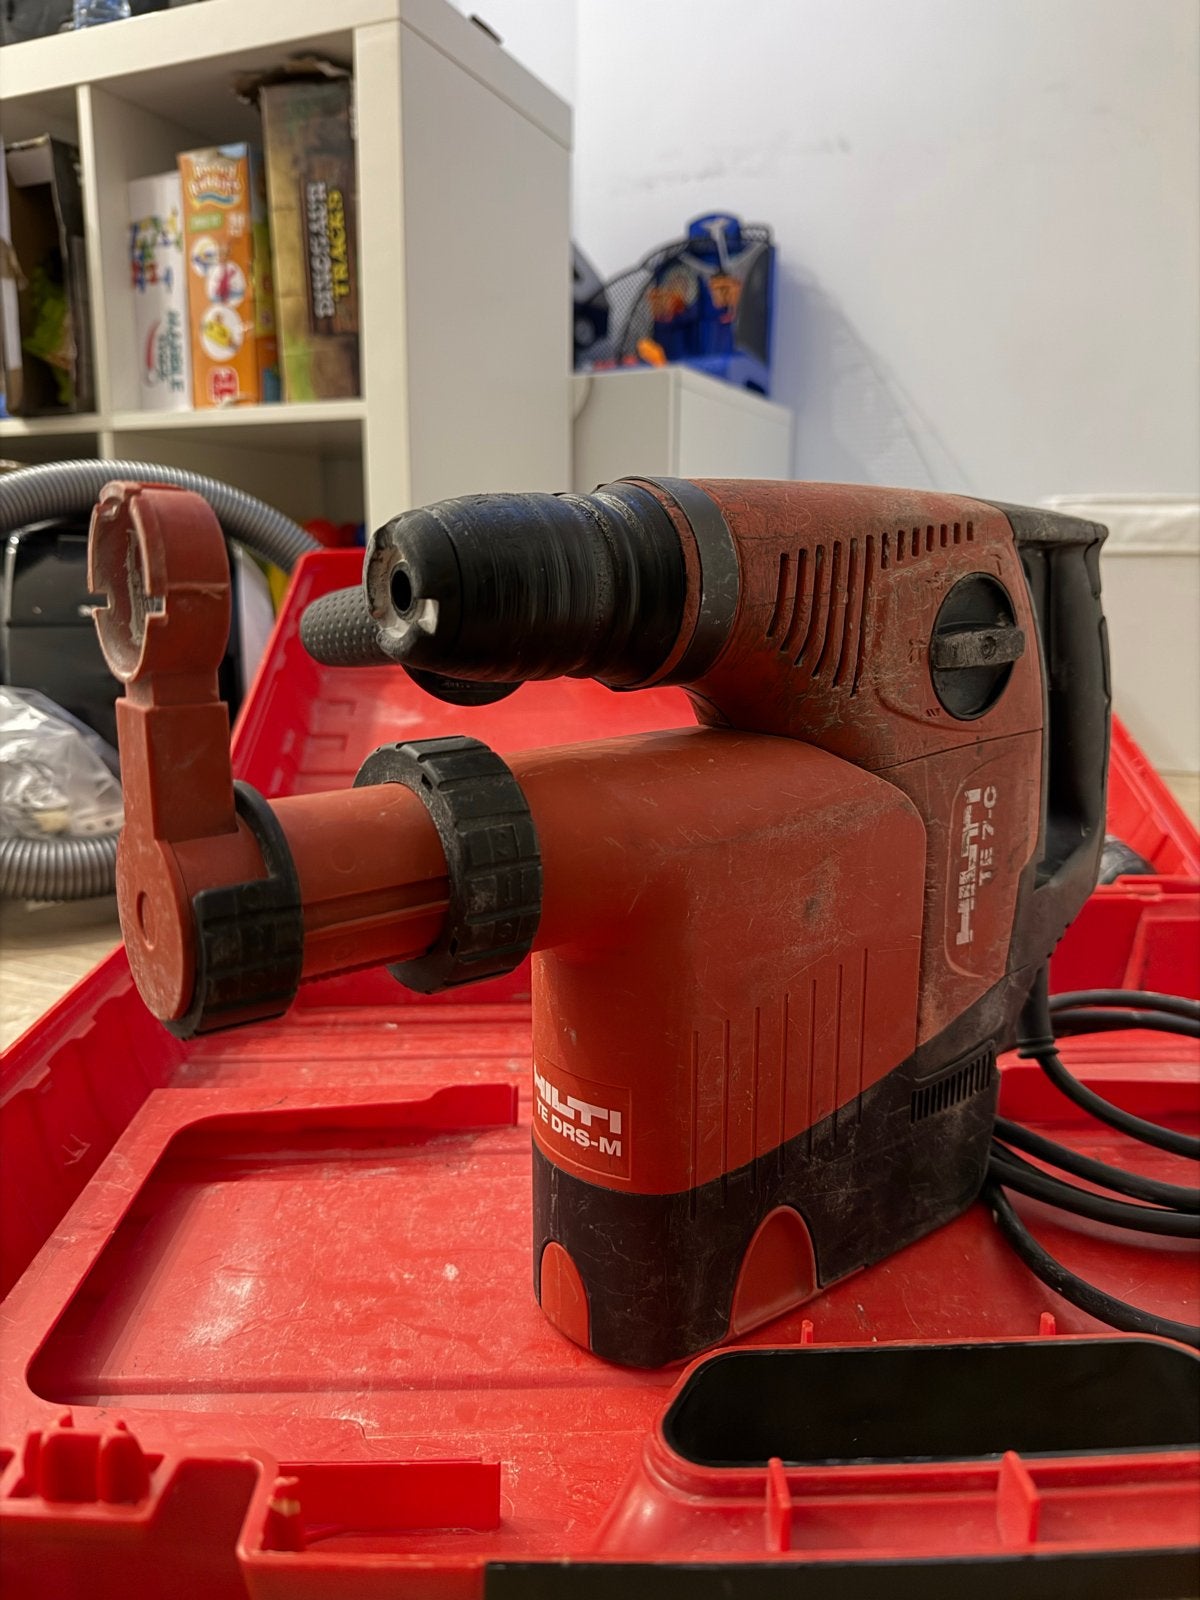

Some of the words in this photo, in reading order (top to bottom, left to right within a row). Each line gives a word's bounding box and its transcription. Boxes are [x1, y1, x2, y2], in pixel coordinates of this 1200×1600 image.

[327, 190, 349, 298] TRACKS
[981, 785, 998, 840] 7-C
[956, 787, 983, 946] HILTI
[979, 847, 994, 886] TE
[536, 1097, 549, 1125] TE
[551, 1115, 622, 1157] DRS-M
